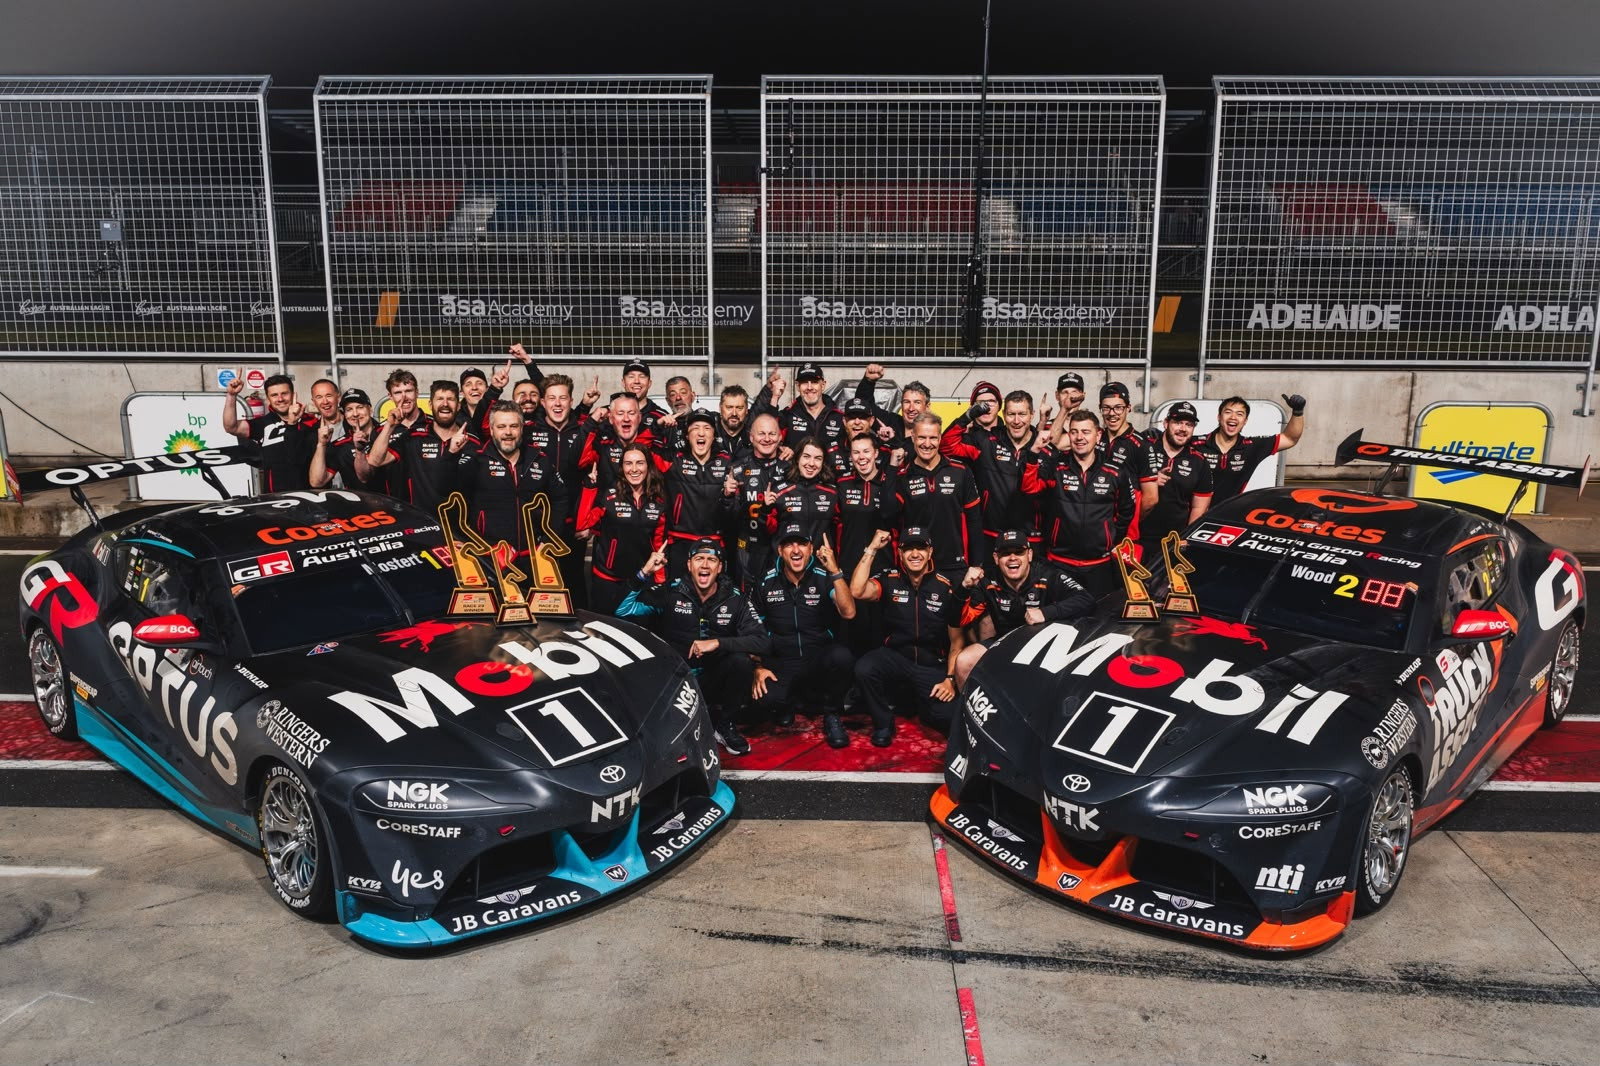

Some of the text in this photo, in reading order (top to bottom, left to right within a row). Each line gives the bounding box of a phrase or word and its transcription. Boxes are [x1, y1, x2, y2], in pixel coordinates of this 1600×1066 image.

[251, 300, 276, 317] Cooper
[488, 300, 573, 321] Academy
[848, 302, 936, 323] Academy
[1029, 303, 1117, 324] Academy
[1247, 304, 1401, 330] ADELAIDE
[1493, 305, 1594, 331] ADELA
[187, 413, 207, 428] bp
[46, 449, 231, 485] OPTUS
[1389, 448, 1575, 479] TRUCK ASSIST
[257, 511, 396, 545] Coates
[296, 524, 441, 556] TOYOTA GAZOO Racing
[1189, 529, 1240, 547] GR
[1245, 508, 1387, 544] Coates
[303, 541, 404, 568] Australia
[420, 551, 442, 570] 1
[1238, 539, 1348, 566] Australia
[1250, 531, 1422, 569] TOYOTA GAZOO Racing
[233, 559, 294, 582] GR
[1291, 564, 1359, 599] Wood 2
[20, 560, 99, 648] GR
[169, 624, 196, 634] BOC
[1489, 621, 1509, 630] BOC
[238, 667, 269, 689] DUNLOP
[327, 620, 656, 743] Mobil
[1011, 622, 1350, 745] Mobil
[1400, 657, 1422, 684] DUNLOP
[673, 681, 697, 715] NGK
[968, 686, 998, 722] NGK
[1427, 642, 1492, 751] TRUCK
[274, 707, 331, 753] RINGERS
[538, 699, 597, 748] 1
[1090, 704, 1139, 757] 1
[1372, 698, 1409, 743] RINGERS
[1386, 710, 1418, 756] WESTERN
[266, 719, 318, 770] WESTERN
[272, 767, 307, 793] DUNLOP
[387, 780, 450, 803] NGK
[1242, 783, 1308, 808] NGK
[387, 801, 448, 810] SPARK PLUGS
[591, 782, 643, 823] NTK
[1043, 790, 1100, 832] NTK
[1248, 804, 1308, 815] SPARK PLUGS
[650, 805, 722, 862] JB Caravans
[948, 813, 1028, 871] JB Caravans
[348, 875, 382, 889] KYB
[391, 859, 445, 898] yes
[1256, 863, 1305, 891] nti
[1316, 875, 1347, 889] KYB
[452, 890, 582, 933] JB Caravans
[1109, 894, 1244, 936] JB Caravans
